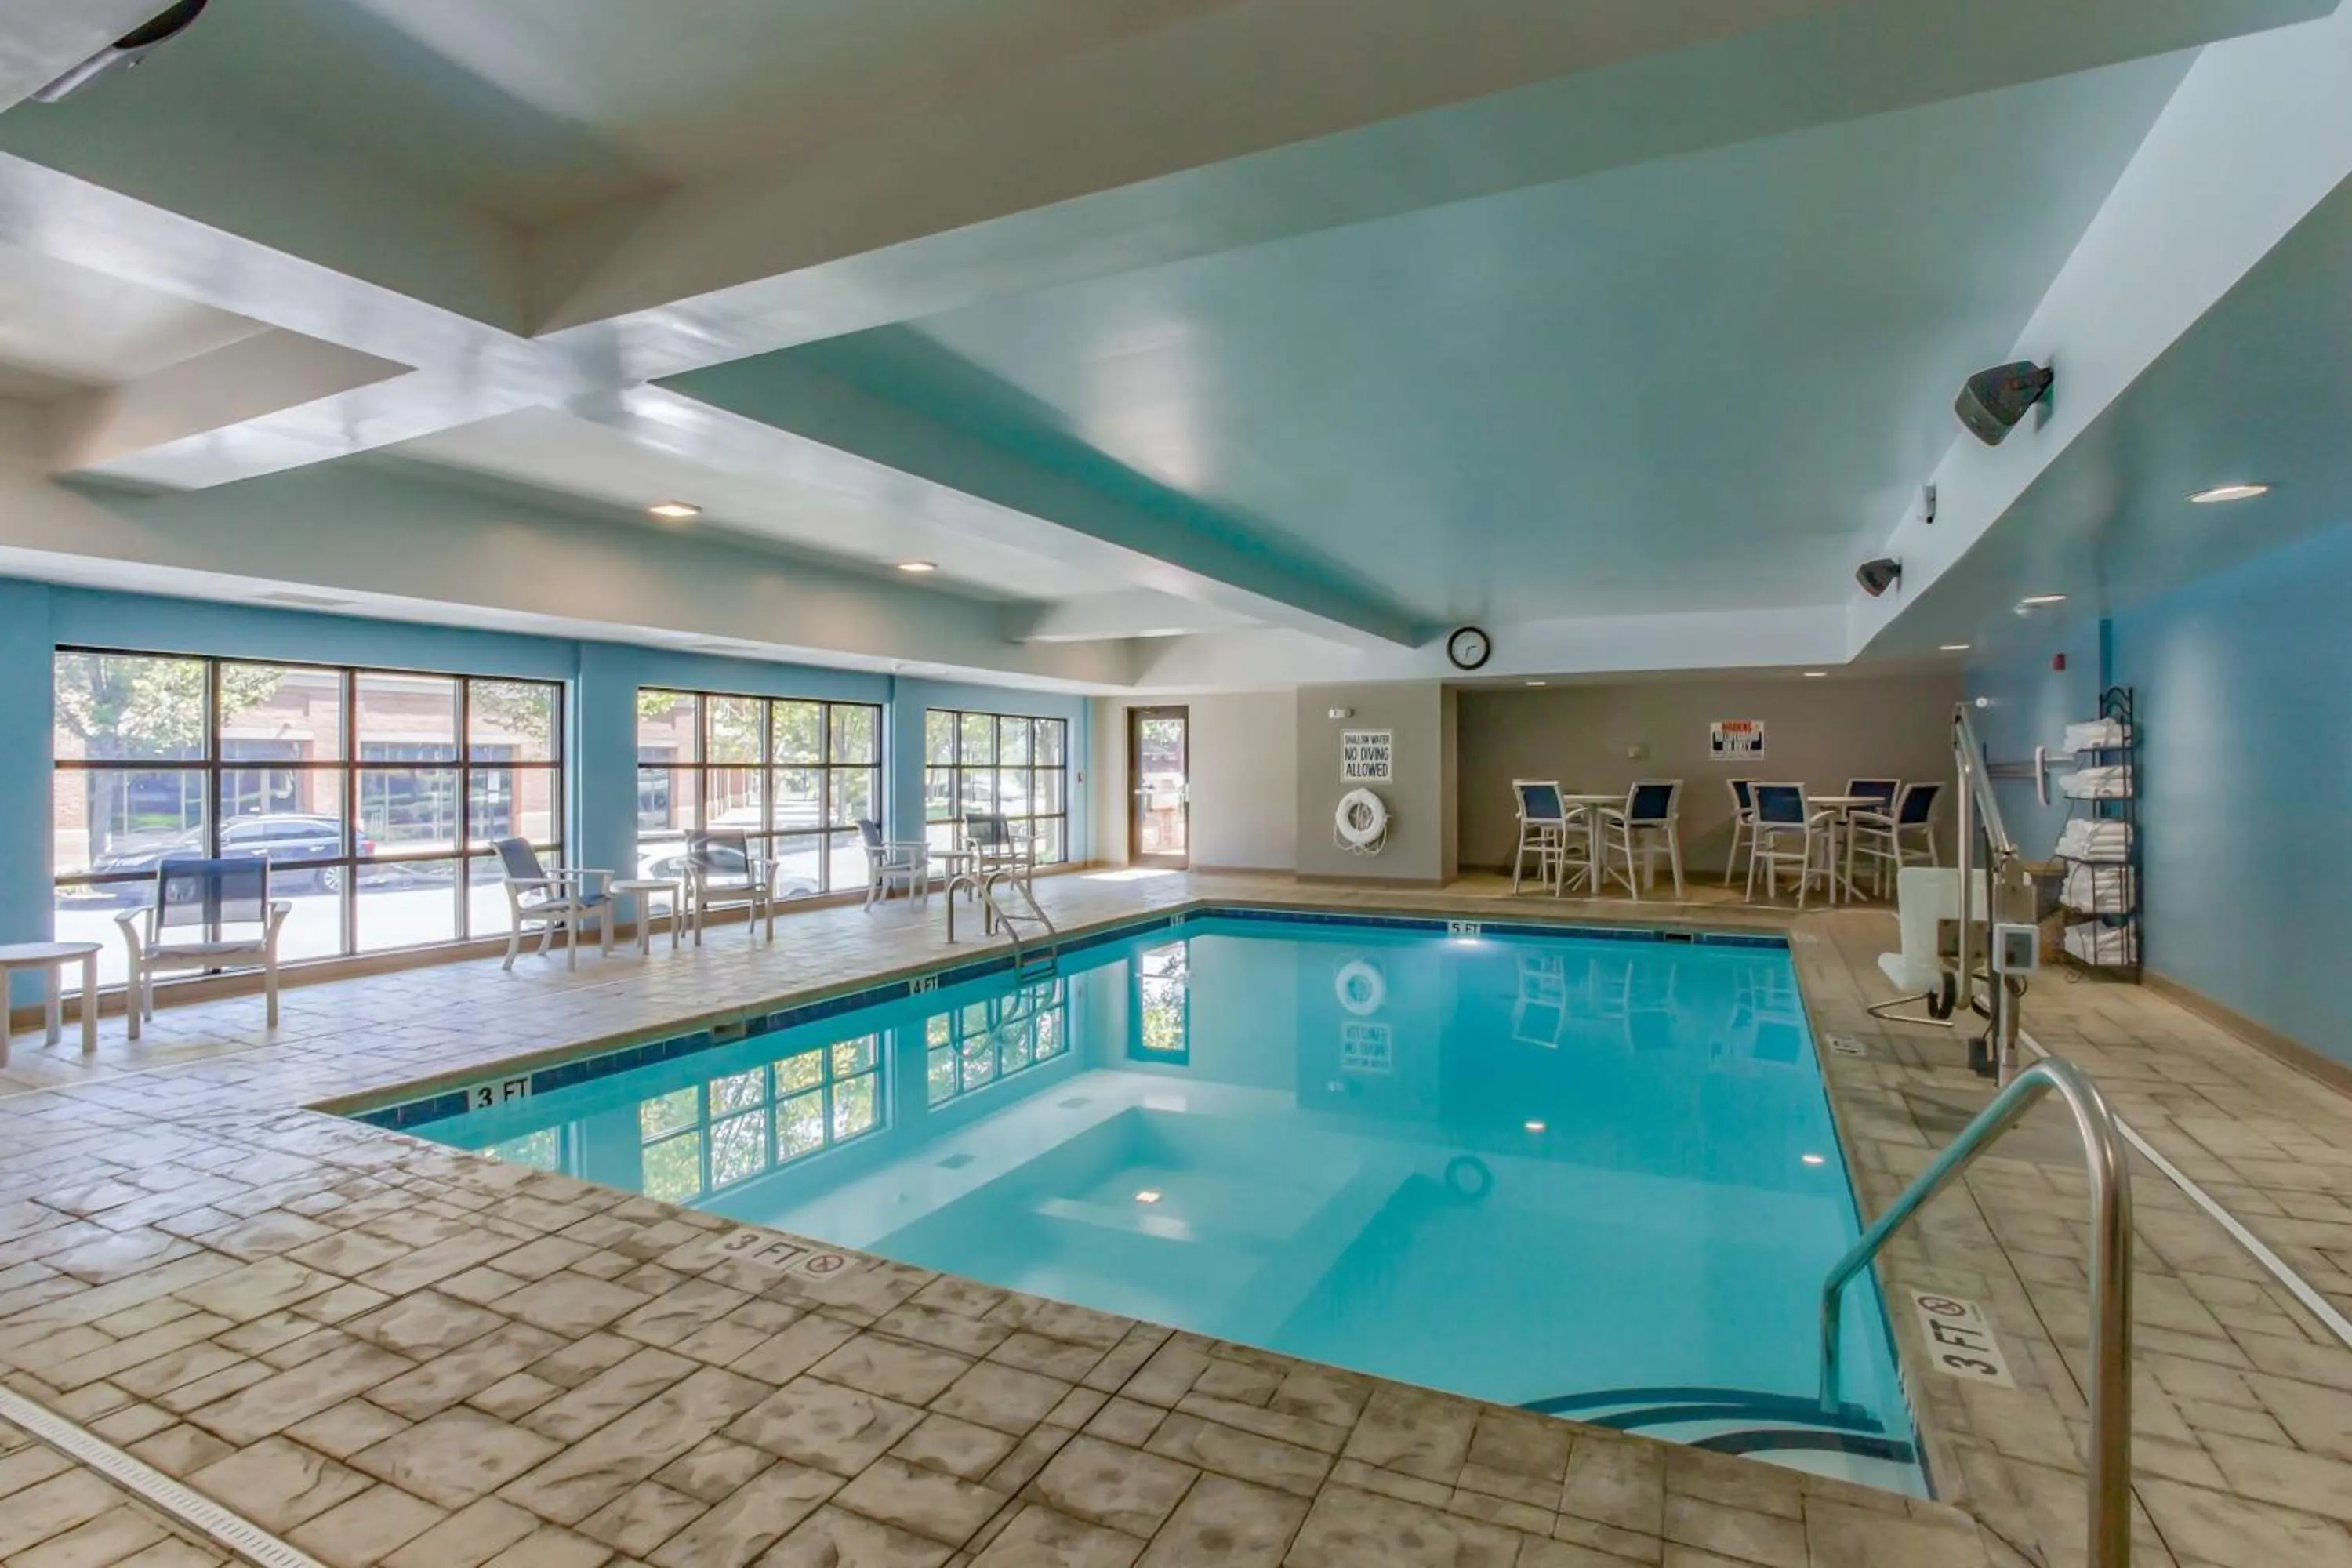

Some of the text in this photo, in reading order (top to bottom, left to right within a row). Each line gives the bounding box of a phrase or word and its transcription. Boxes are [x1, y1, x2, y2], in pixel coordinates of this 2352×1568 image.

[1345, 747, 1389, 760] NO DIVING
[1346, 763, 1388, 777] ALLOWED
[1465, 923, 1477, 935] FT
[924, 976, 936, 992] FT
[477, 1076, 528, 1109] 3 FT
[723, 1233, 810, 1265] 3 FT
[1929, 1318, 1998, 1376] 3 FT
